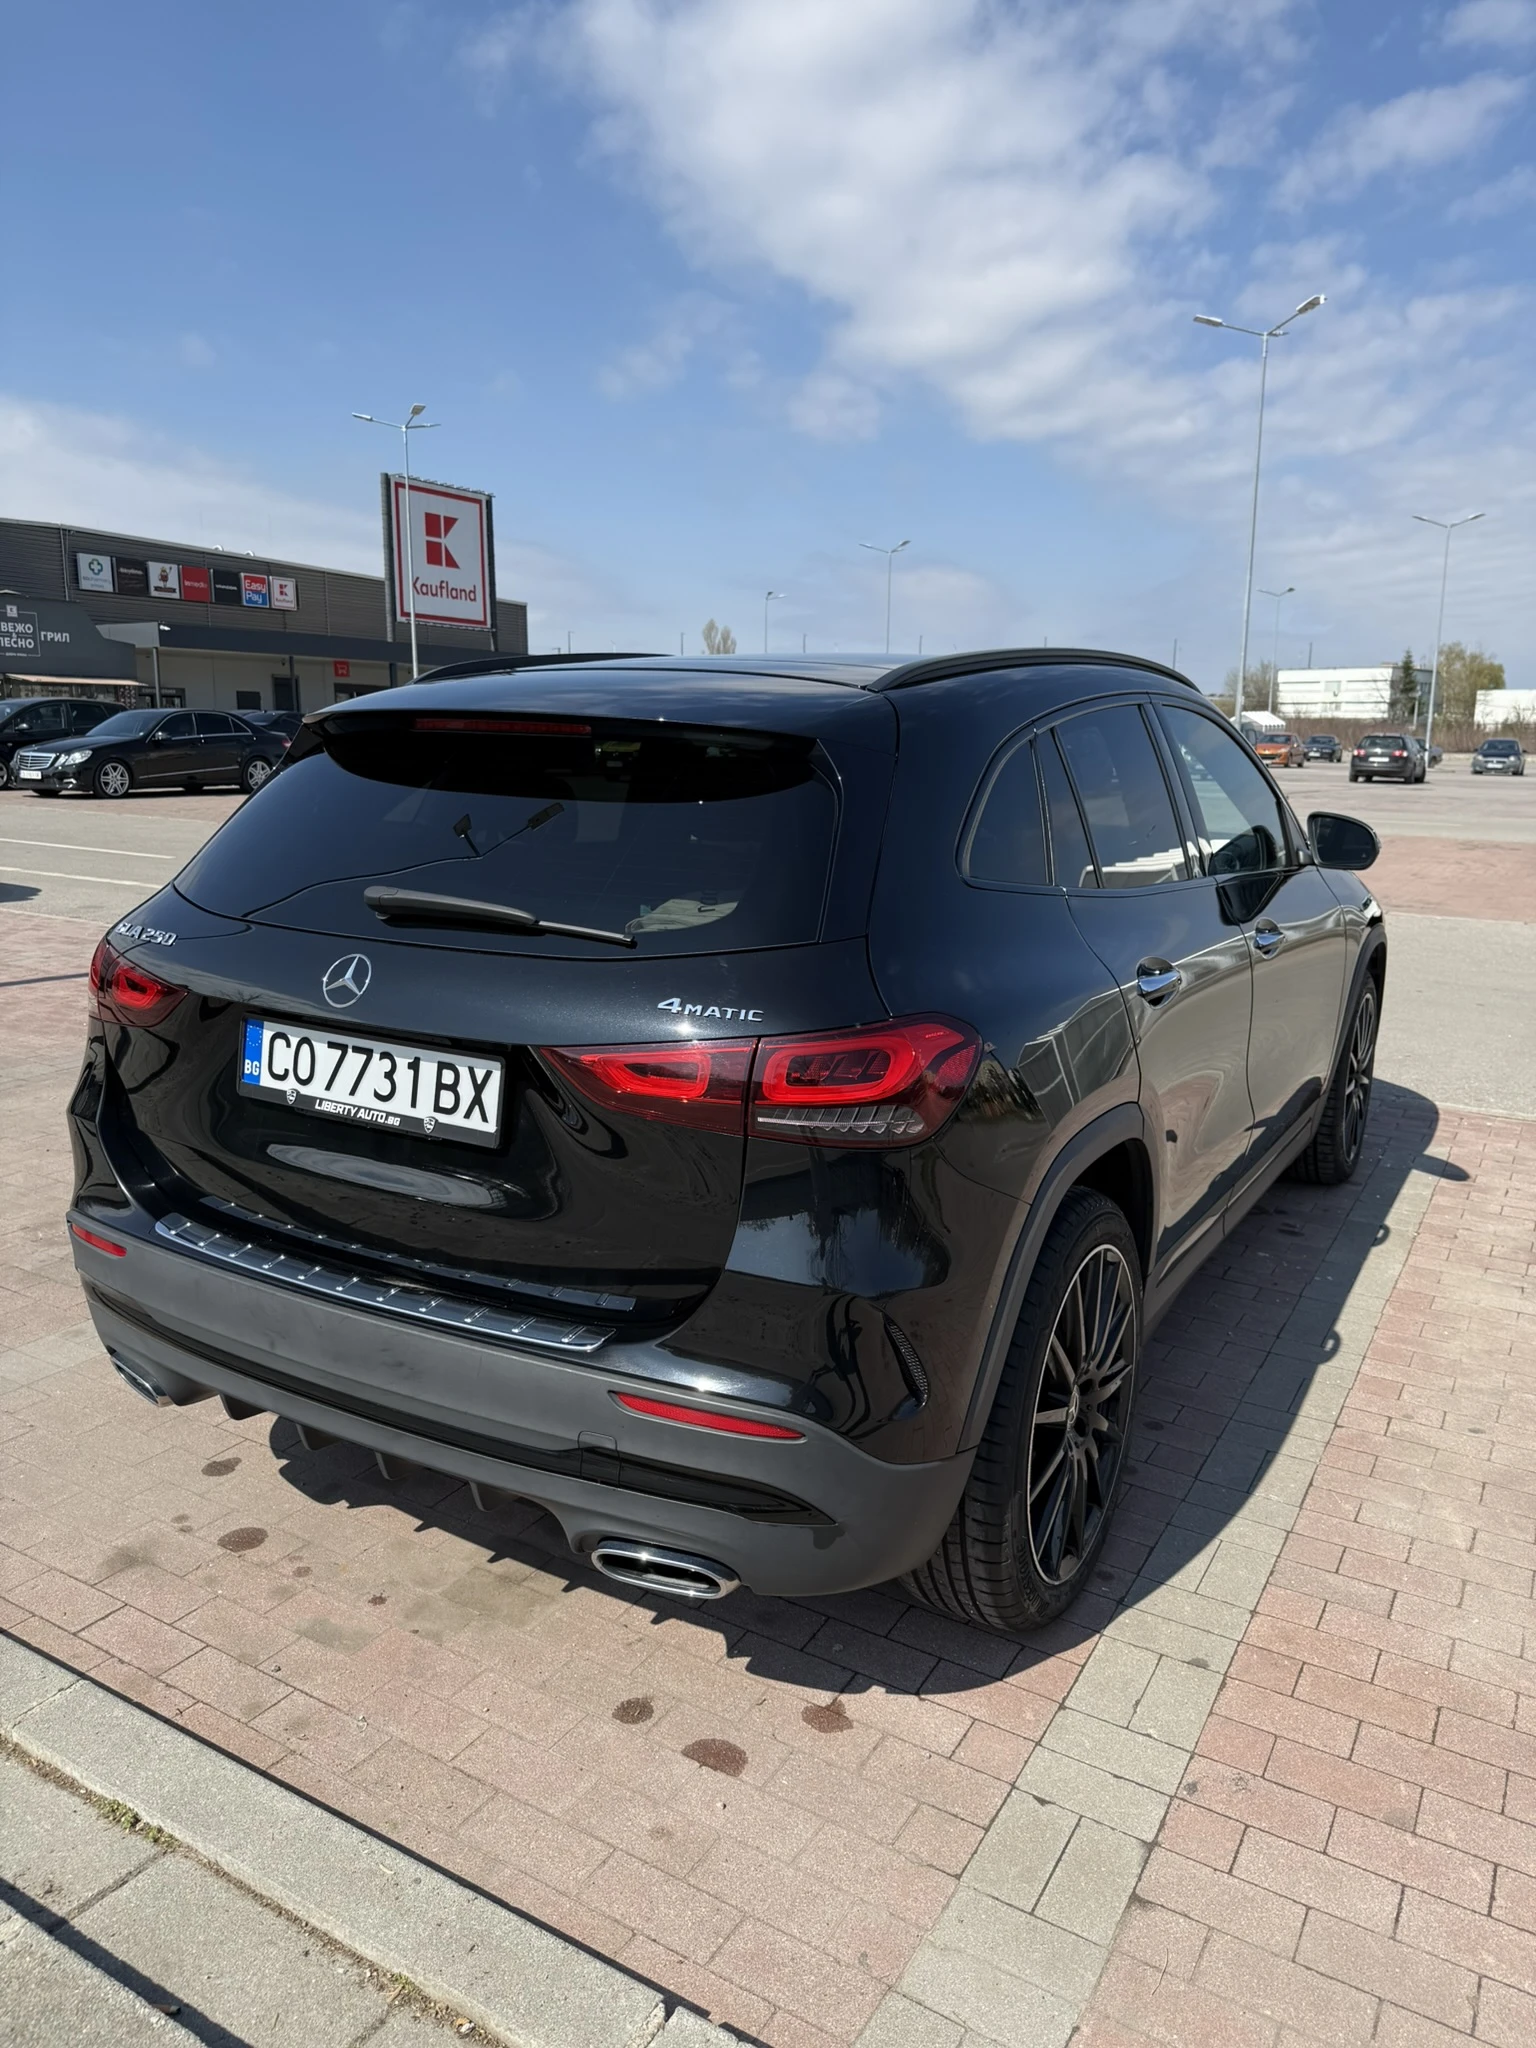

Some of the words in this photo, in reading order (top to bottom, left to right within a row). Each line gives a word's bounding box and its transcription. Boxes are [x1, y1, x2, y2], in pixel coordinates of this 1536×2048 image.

[245, 580, 266, 593] Easy
[412, 576, 477, 602] Kaufland
[246, 591, 262, 604] Pay
[0, 622, 34, 634] ВЕЖО
[41, 631, 70, 643] ГРИЛ
[141, 928, 177, 946] 250
[657, 997, 765, 1022] 4MATIC
[244, 1059, 260, 1076] BG
